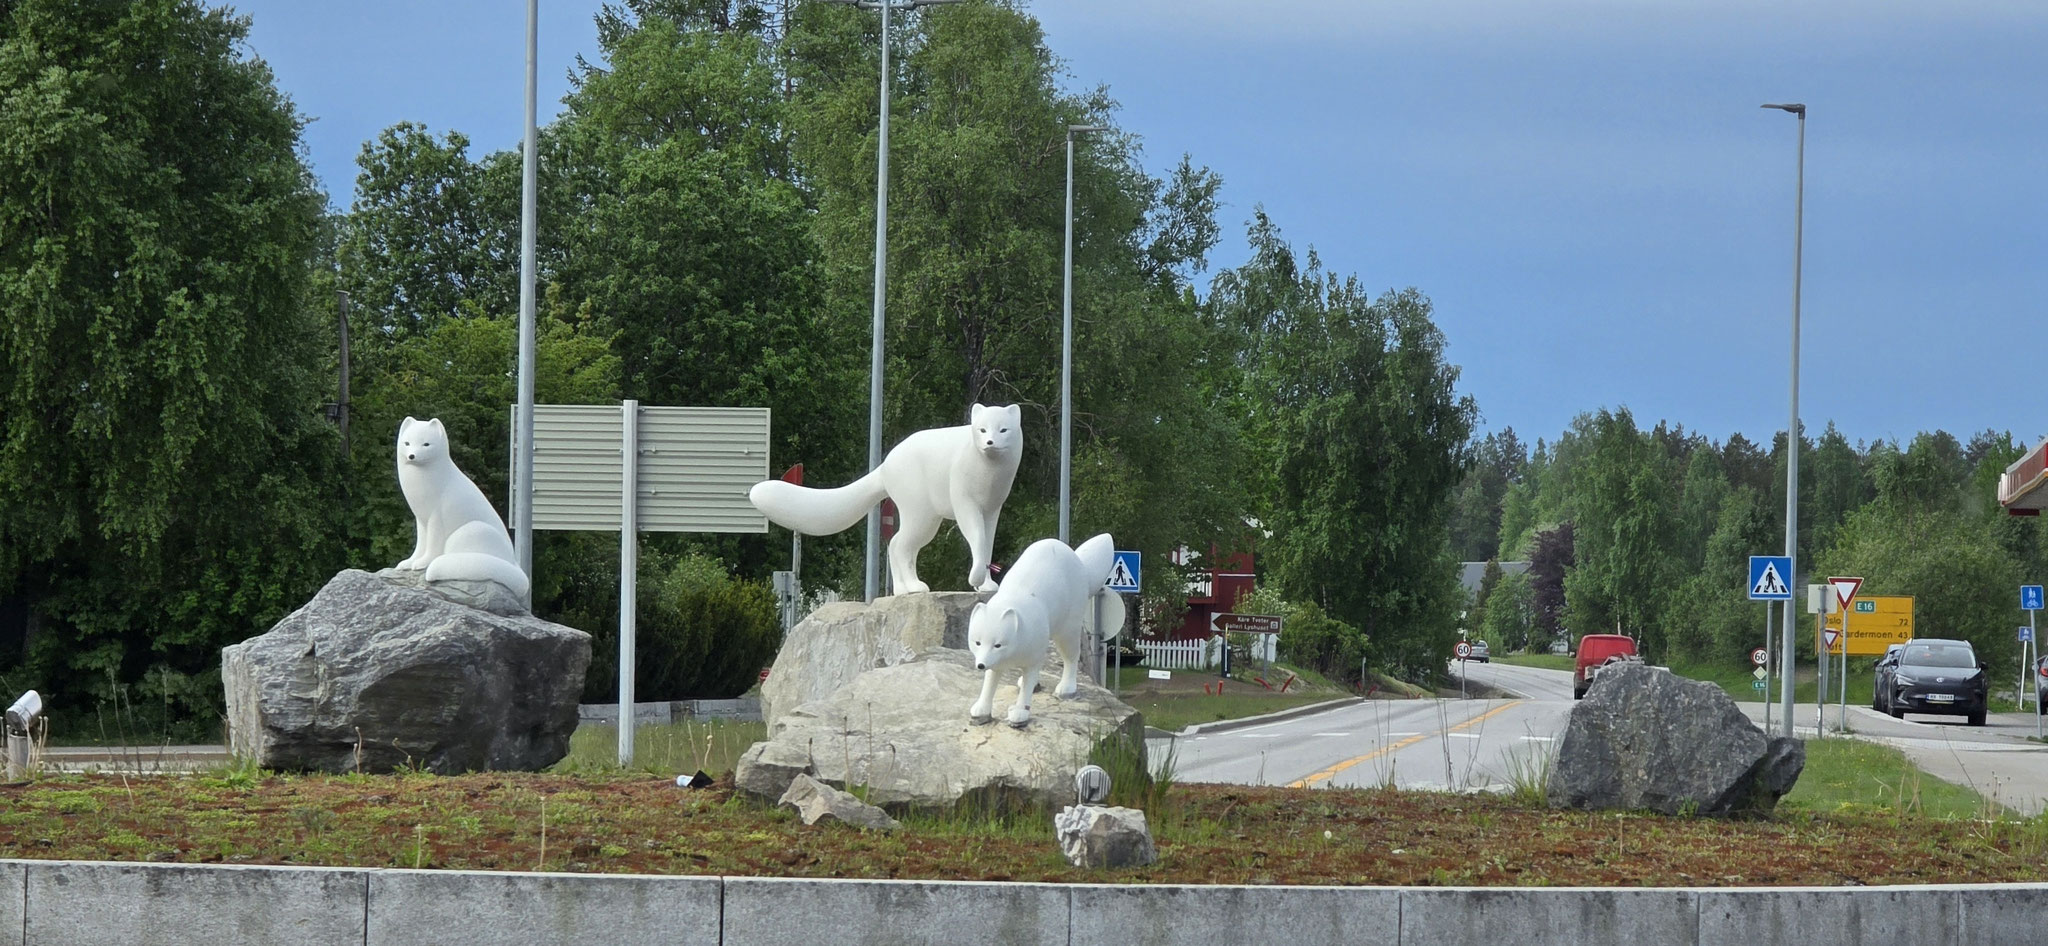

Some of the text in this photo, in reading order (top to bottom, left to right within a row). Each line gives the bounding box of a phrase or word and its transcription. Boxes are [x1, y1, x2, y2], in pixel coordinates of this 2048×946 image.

[1857, 602, 1873, 611] E 16
[1899, 618, 1909, 626] 72
[1458, 645, 1469, 654] 60
[1755, 652, 1766, 661] 60
